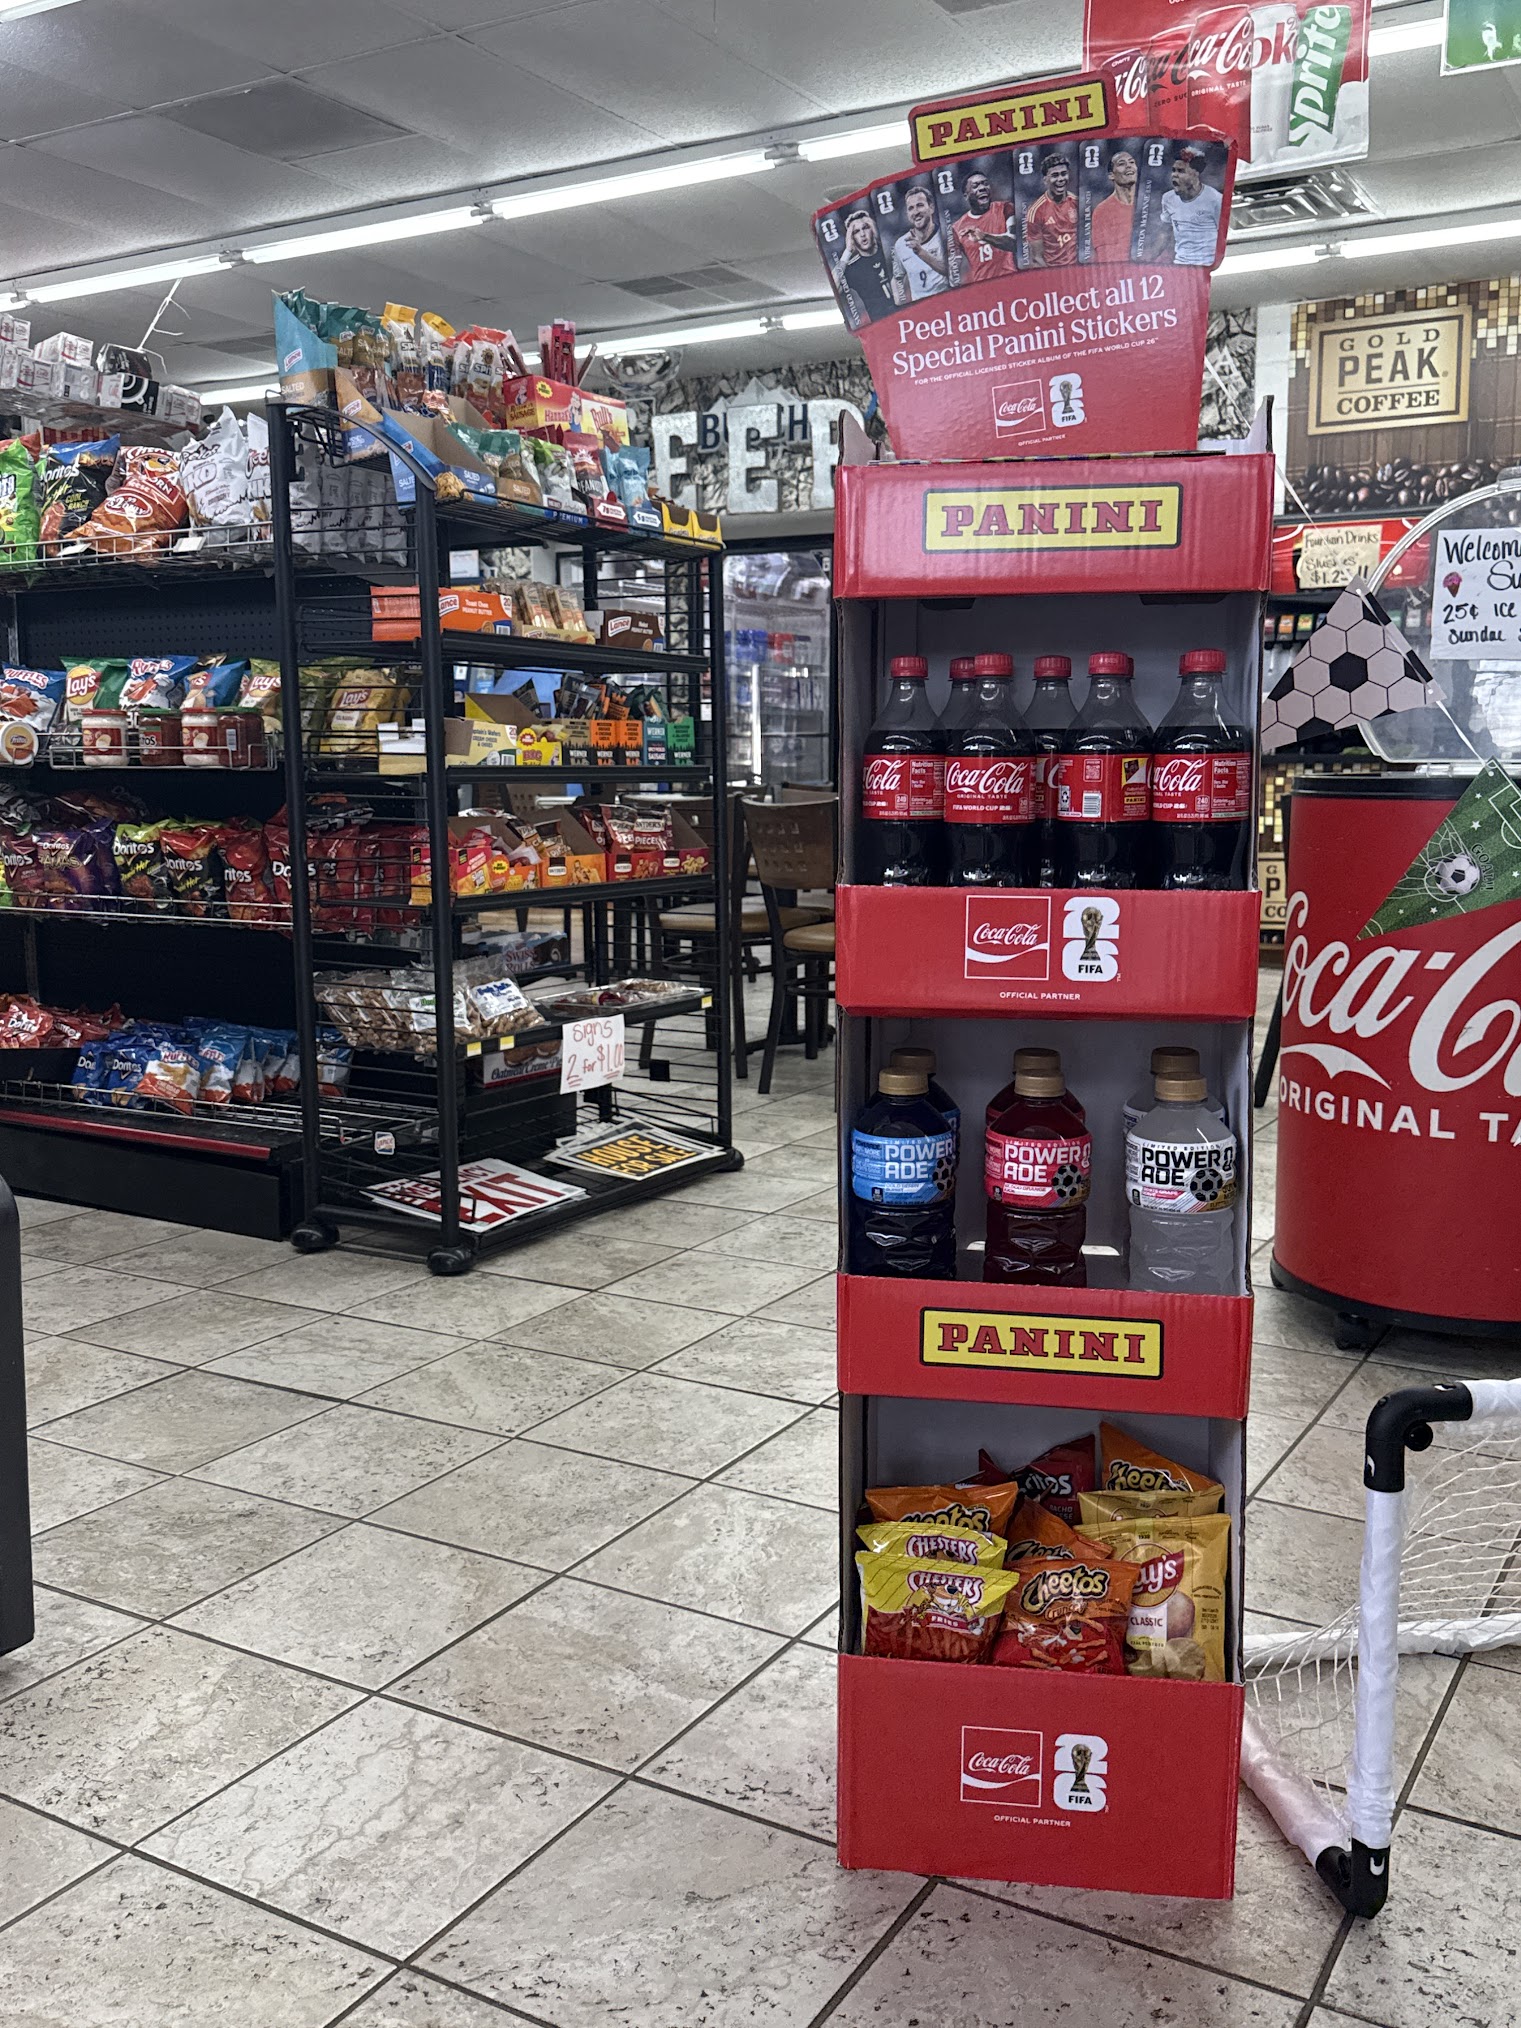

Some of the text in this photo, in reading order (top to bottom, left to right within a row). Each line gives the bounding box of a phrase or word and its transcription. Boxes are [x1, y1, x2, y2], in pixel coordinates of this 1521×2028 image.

[1191, 80, 1247, 97] ORIGINAL TASTE
[1289, 6, 1341, 151] Sprite
[928, 94, 1093, 148] PANINI
[1136, 229, 1146, 258] WESTON
[898, 274, 1165, 344] Peel and Collect all 12
[892, 307, 1178, 378] Special Panini Stickers
[1339, 328, 1440, 352] GOLD
[914, 378, 929, 386] FOR
[929, 376, 943, 384] THE
[944, 371, 974, 381] OFFICIAL
[975, 364, 1007, 375] LICENSED
[1008, 359, 1036, 369] STICKER
[1037, 355, 1061, 364] ALBUM
[1062, 353, 1072, 361] OF
[1073, 350, 1088, 358] THE
[1088, 347, 1103, 355] FIFA
[1104, 343, 1130, 353] WORLD
[1131, 340, 1145, 348] CUP
[1338, 346, 1441, 388] PEAK
[998, 396, 1039, 417] Coca-Cola
[1336, 389, 1440, 416] COFFEE
[1061, 414, 1077, 423] FIFA
[1018, 434, 1066, 447] OFFICIAL PARTNER
[463, 470, 480, 481] SALTED
[513, 484, 531, 495] SALTED
[941, 500, 1163, 537] PANINI
[1345, 530, 1379, 545] Drinks
[610, 619, 630, 630] Lance
[67, 672, 97, 697] Lay's
[341, 690, 369, 707] Lay's
[946, 761, 1029, 794] Coca-Cola
[42, 842, 70, 850] Doritos
[113, 842, 155, 855] Doritos
[225, 868, 251, 883] ritos
[973, 922, 1042, 946] Coca-Cola
[505, 950, 538, 962] SWISS
[1078, 964, 1103, 974] FIFA
[999, 991, 1081, 1001] OFFICIAL PARTNER
[113, 1059, 142, 1073] Doritos
[491, 1059, 549, 1080] Oatmeal Creme
[567, 1054, 580, 1081] 2
[583, 1059, 597, 1074] for
[1279, 1076, 1456, 1140] ORIGINAL
[575, 1135, 665, 1167] HOUSE
[885, 1138, 953, 1162] POWER
[1005, 1143, 1081, 1165] POWER
[1142, 1143, 1178, 1151] LIMITED
[1142, 1147, 1221, 1169] POWER
[611, 1147, 698, 1176] FOR SALE
[885, 1161, 929, 1179] ADE
[1004, 1161, 1048, 1183] ADE
[1141, 1165, 1185, 1187] ADE
[937, 1322, 1145, 1363] PANINI
[907, 1534, 978, 1565] CHESTER'S
[908, 1571, 984, 1605] CHESTER'S
[1020, 1564, 1109, 1613] Cheetos
[1130, 1617, 1163, 1627] CLASSIC
[968, 1751, 1034, 1775] Coca-Cola
[1068, 1795, 1093, 1805] FIFA
[993, 1815, 1071, 1827] OFFICIAL PARTNER
